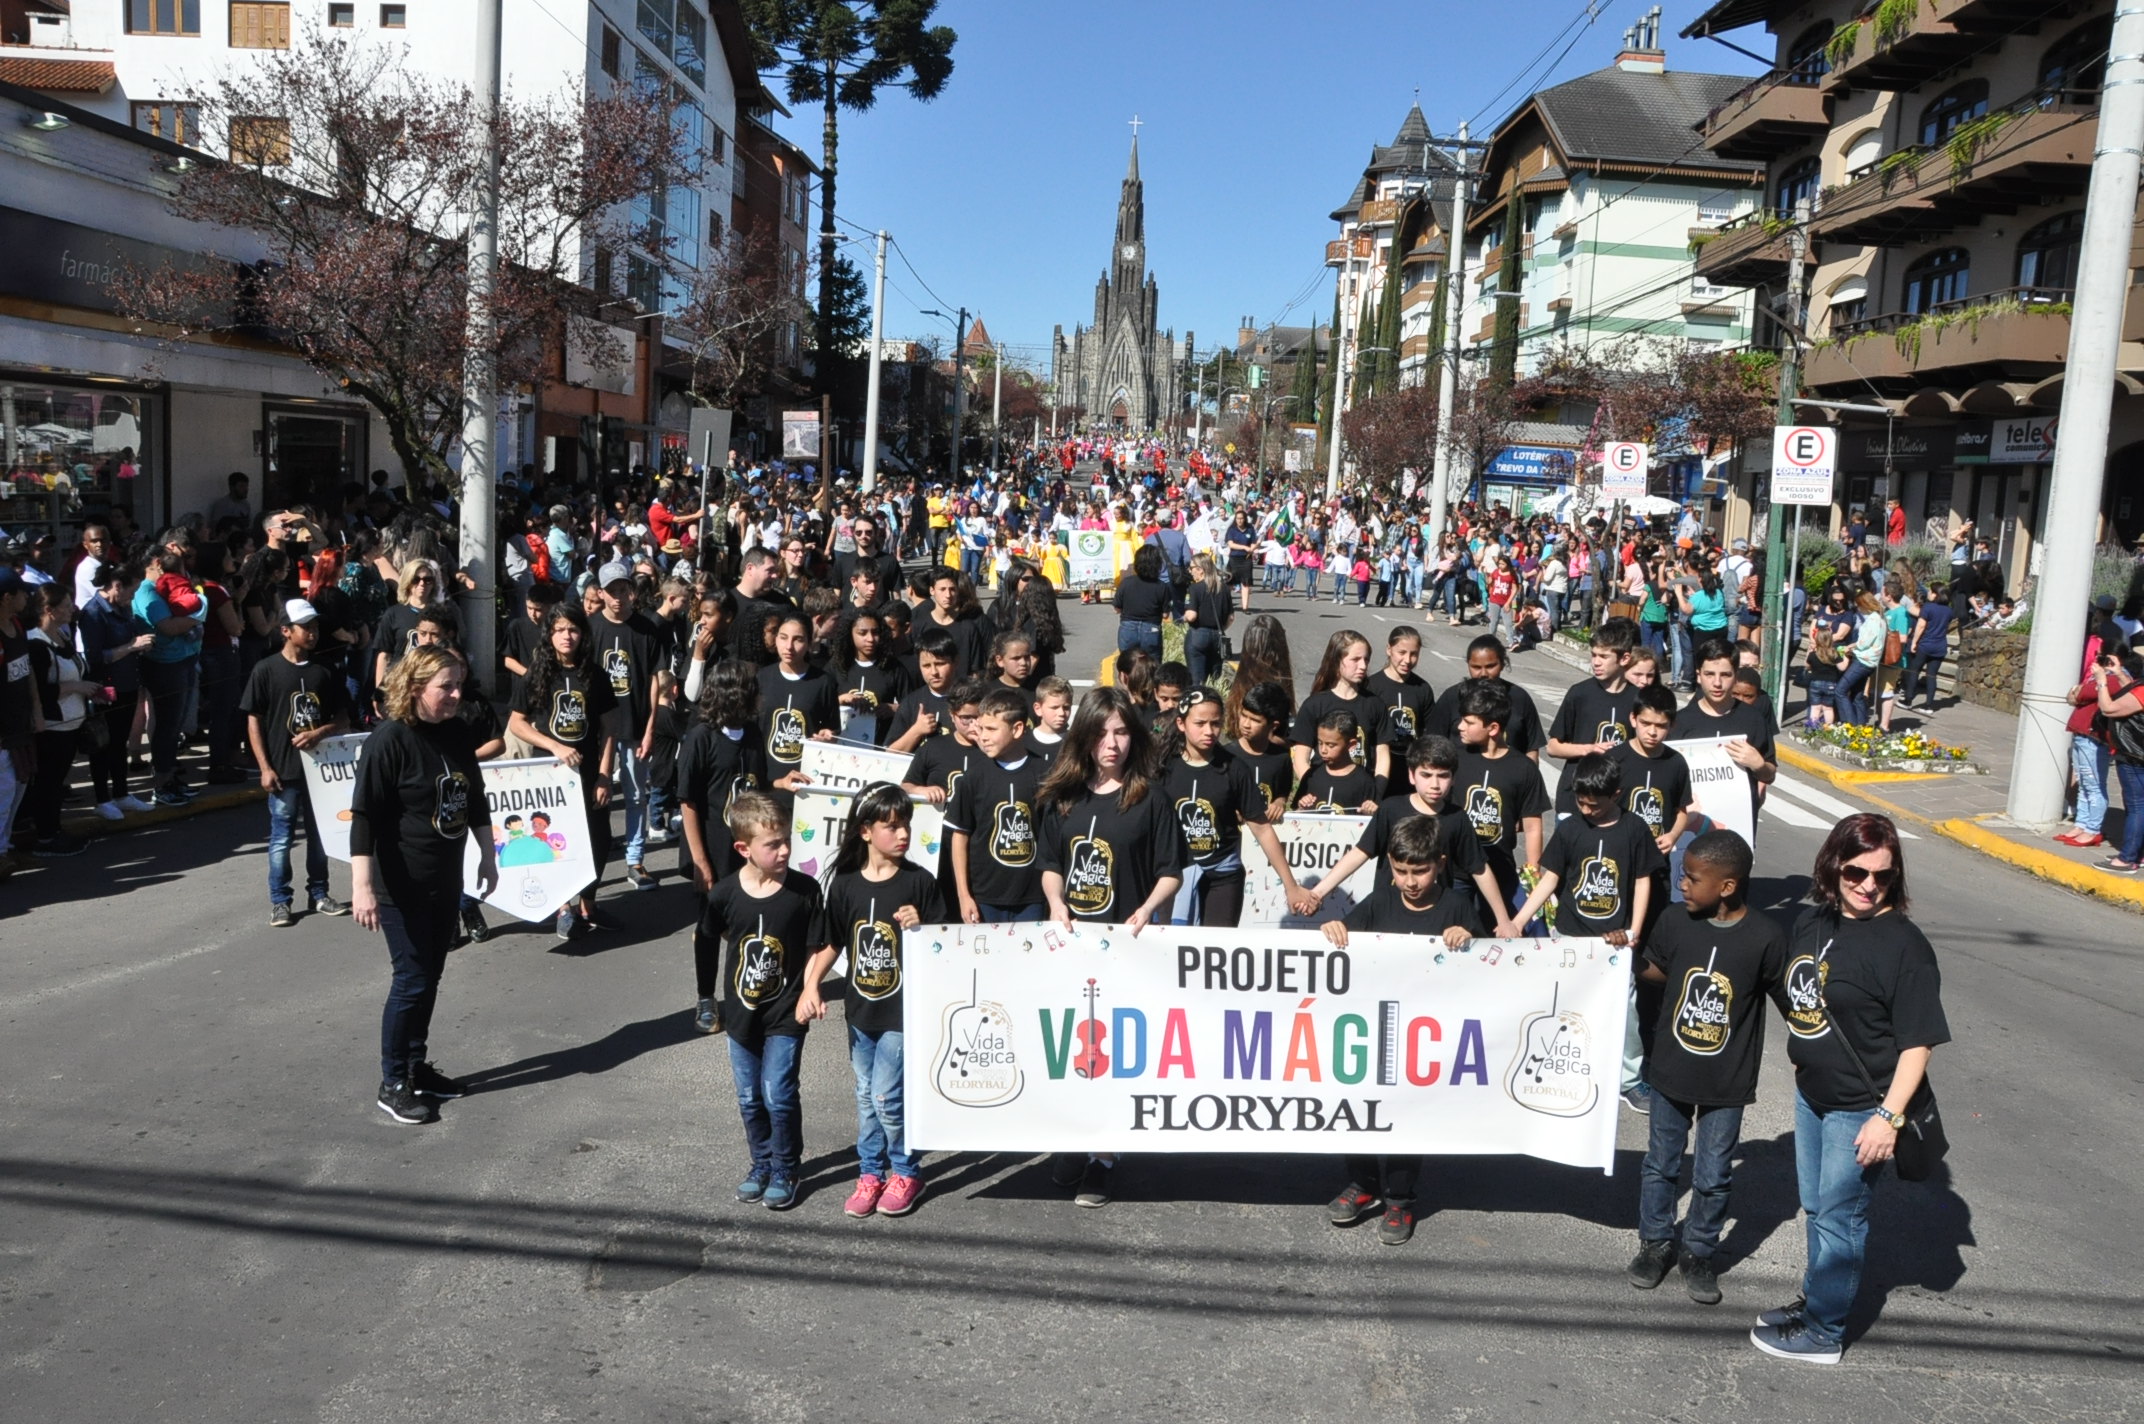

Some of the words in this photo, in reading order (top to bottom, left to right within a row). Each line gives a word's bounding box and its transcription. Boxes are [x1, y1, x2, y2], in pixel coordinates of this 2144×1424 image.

[60, 249, 133, 288] farmác
[1620, 448, 1633, 466] E
[1797, 435, 1814, 459] E
[1177, 945, 1351, 995] PROJETO
[1695, 984, 1724, 1012] Vida
[963, 1016, 1005, 1050] Vida
[1223, 997, 1489, 1087] MÁGICA
[1540, 1025, 1582, 1058] Vida
[949, 1079, 1009, 1090] FLORYBAL
[1523, 1085, 1581, 1101] FLORYBAL
[1130, 1093, 1393, 1132] FLORYBAL
